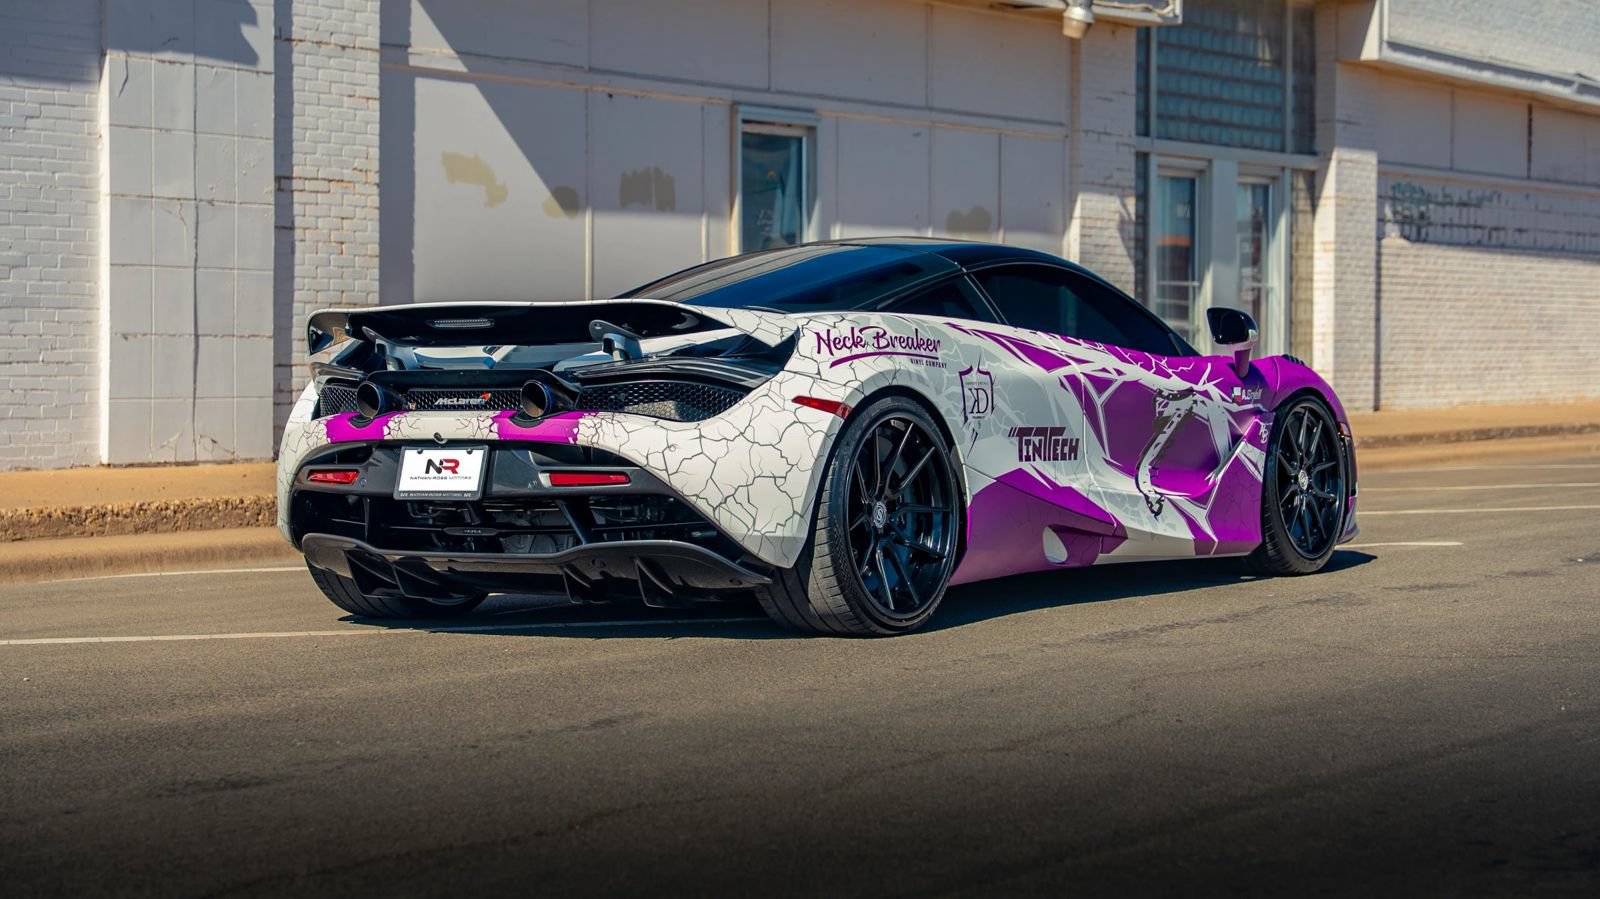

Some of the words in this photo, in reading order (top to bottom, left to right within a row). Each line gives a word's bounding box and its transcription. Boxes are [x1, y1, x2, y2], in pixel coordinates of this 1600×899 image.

[815, 326, 867, 356] Neck
[858, 325, 941, 353] Breaker
[910, 358, 924, 366] VINYL
[925, 360, 947, 369] COMPANY
[434, 397, 486, 405] McLaren
[425, 458, 460, 474] NR
